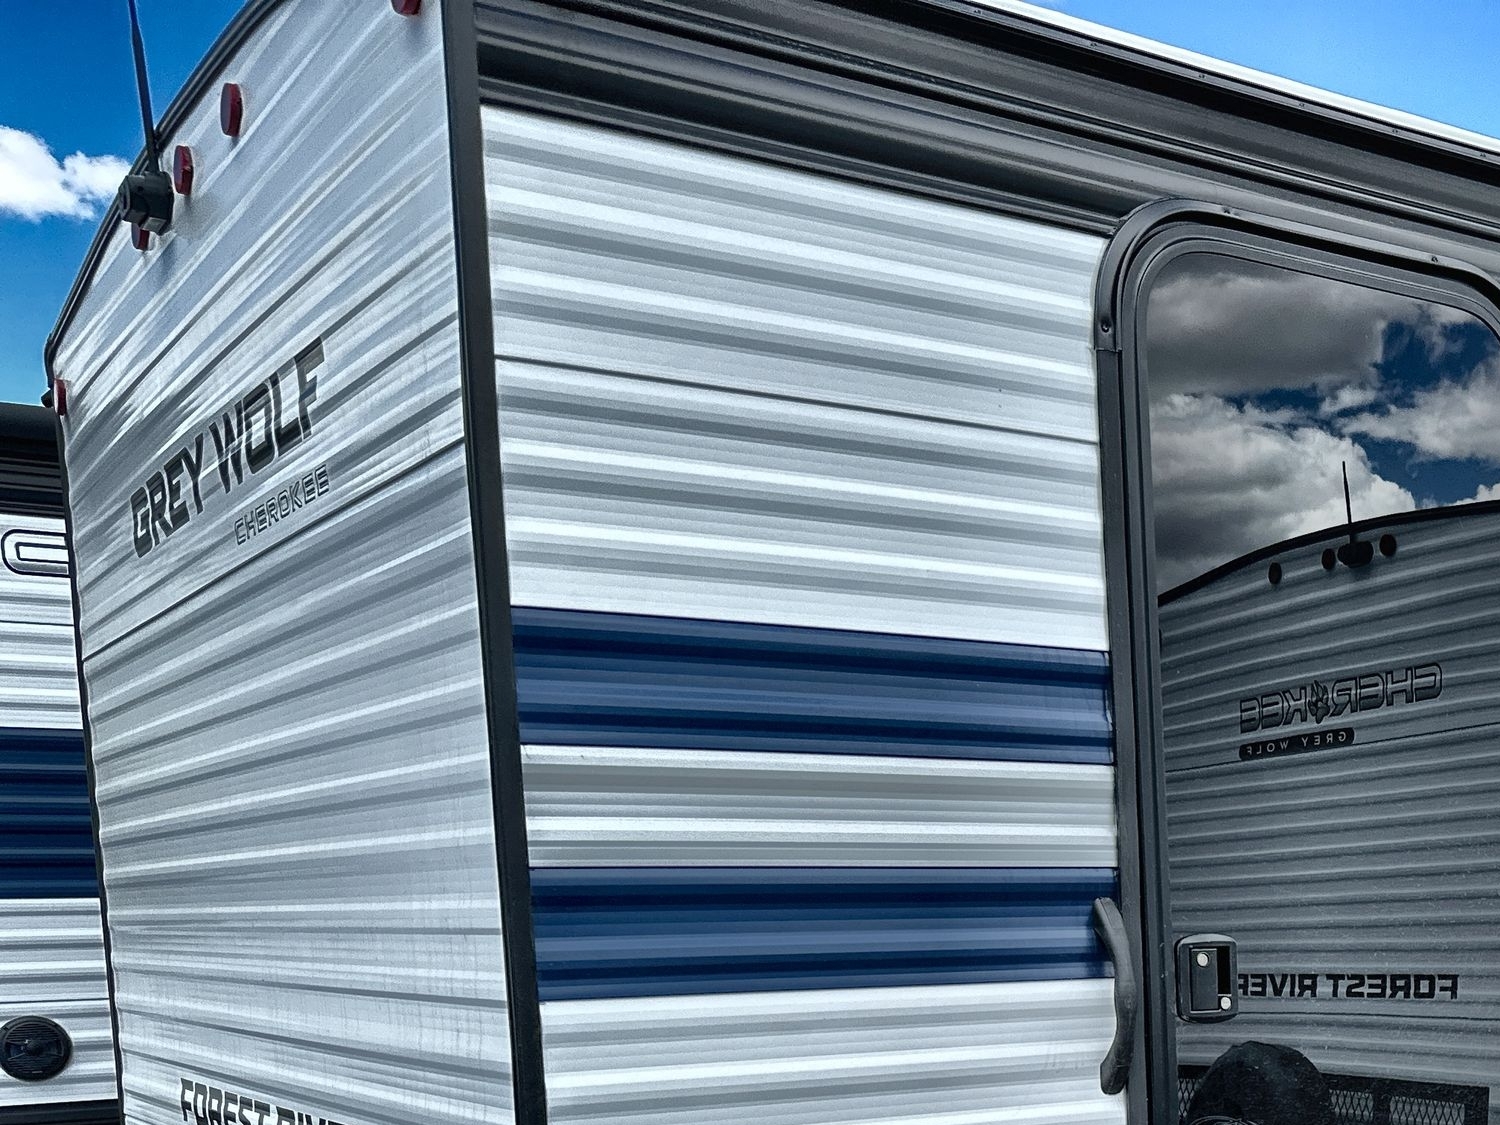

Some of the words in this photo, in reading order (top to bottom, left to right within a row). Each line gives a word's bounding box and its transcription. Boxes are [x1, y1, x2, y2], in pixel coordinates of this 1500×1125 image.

[130, 433, 204, 558] GREY
[208, 336, 325, 494] WOLF
[234, 464, 330, 546] CHEROKEE
